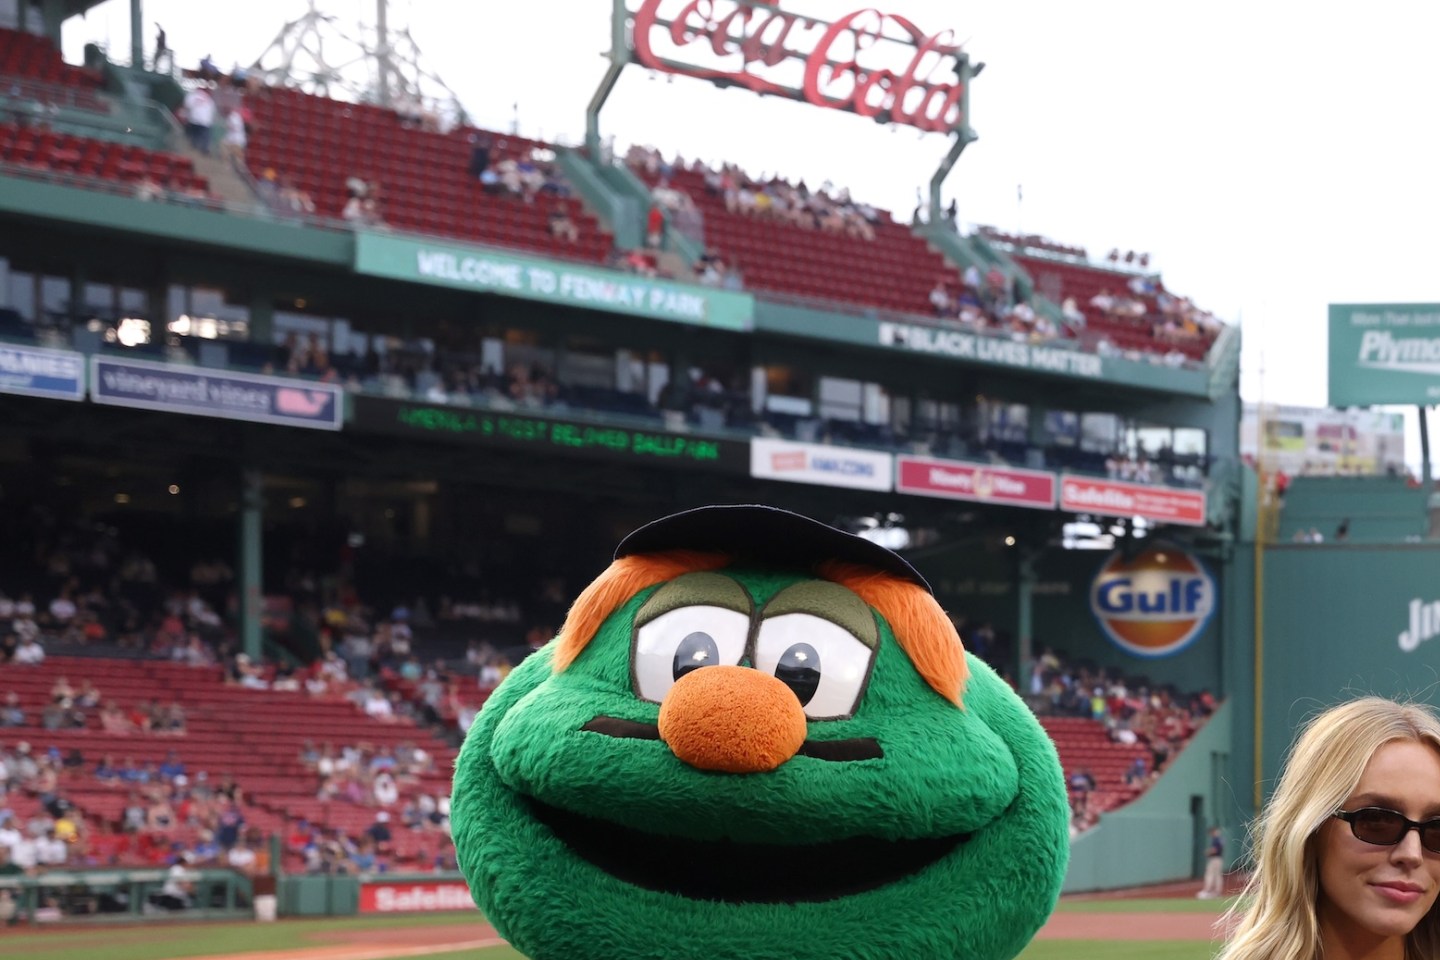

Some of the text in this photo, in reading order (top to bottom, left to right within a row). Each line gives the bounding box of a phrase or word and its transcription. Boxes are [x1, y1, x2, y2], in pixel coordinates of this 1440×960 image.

[416, 250, 706, 317] WELCOME TO FENWAY PARK
[909, 325, 1102, 377] BLACK LIVES MATTER
[1097, 579, 1204, 614] Gulf
